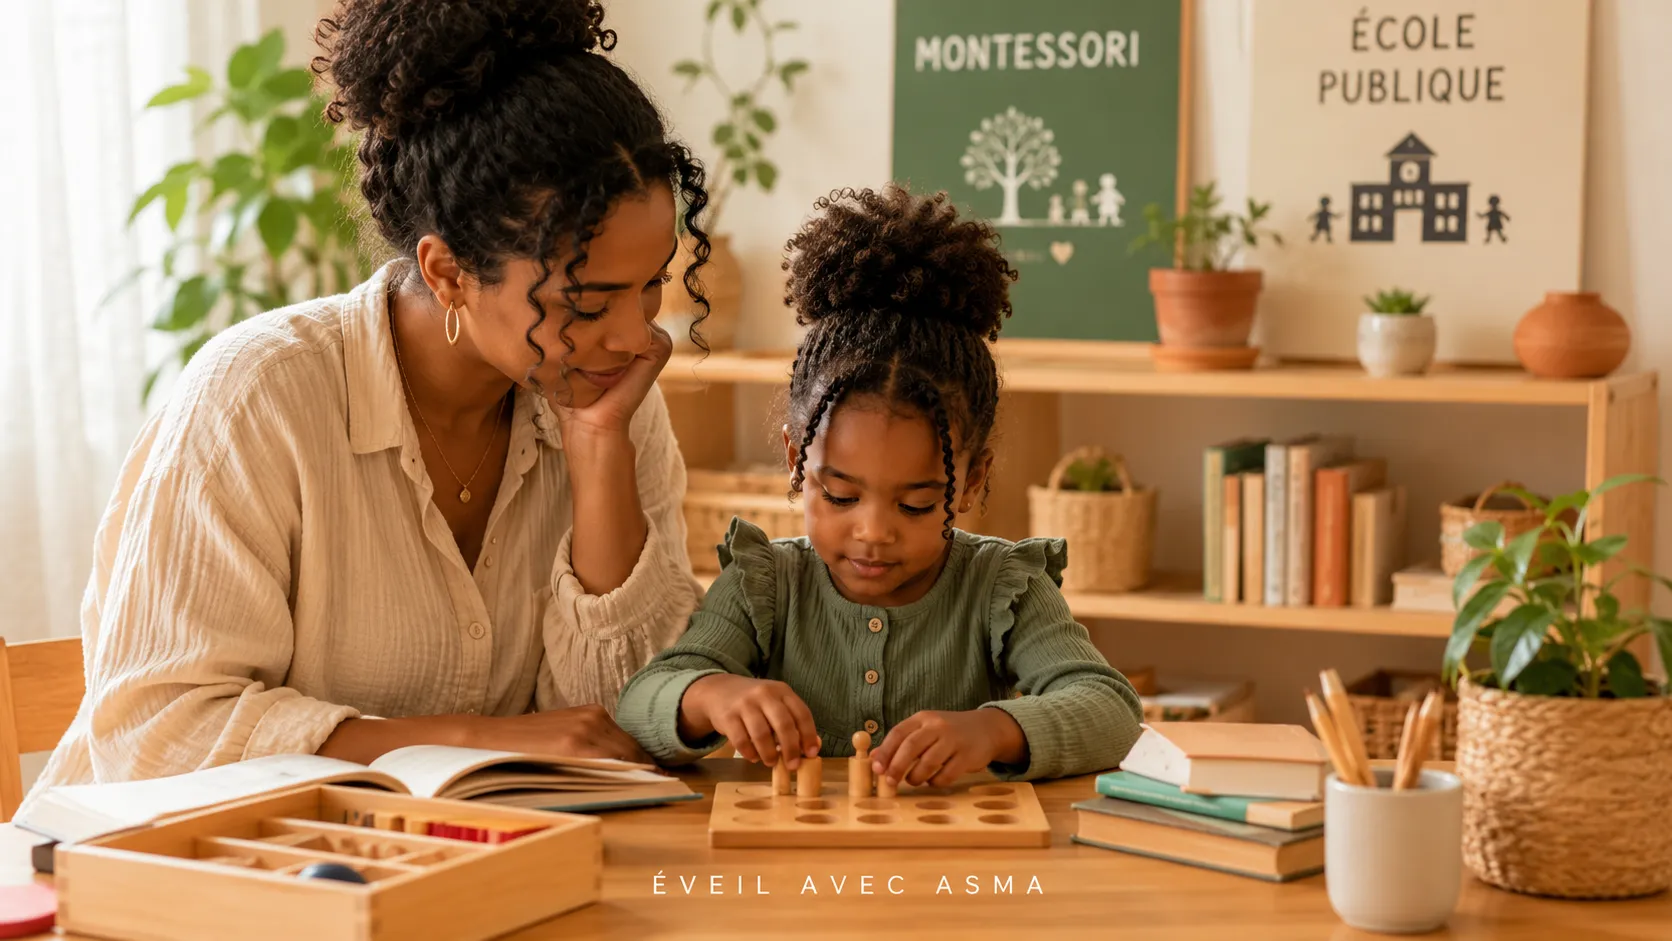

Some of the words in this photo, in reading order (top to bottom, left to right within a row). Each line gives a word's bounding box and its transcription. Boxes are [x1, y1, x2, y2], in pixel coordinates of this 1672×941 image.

[1352, 6, 1475, 51] ÉCOLE
[915, 31, 1139, 72] MONTESSORI
[1318, 66, 1505, 104] PUBLIQUE
